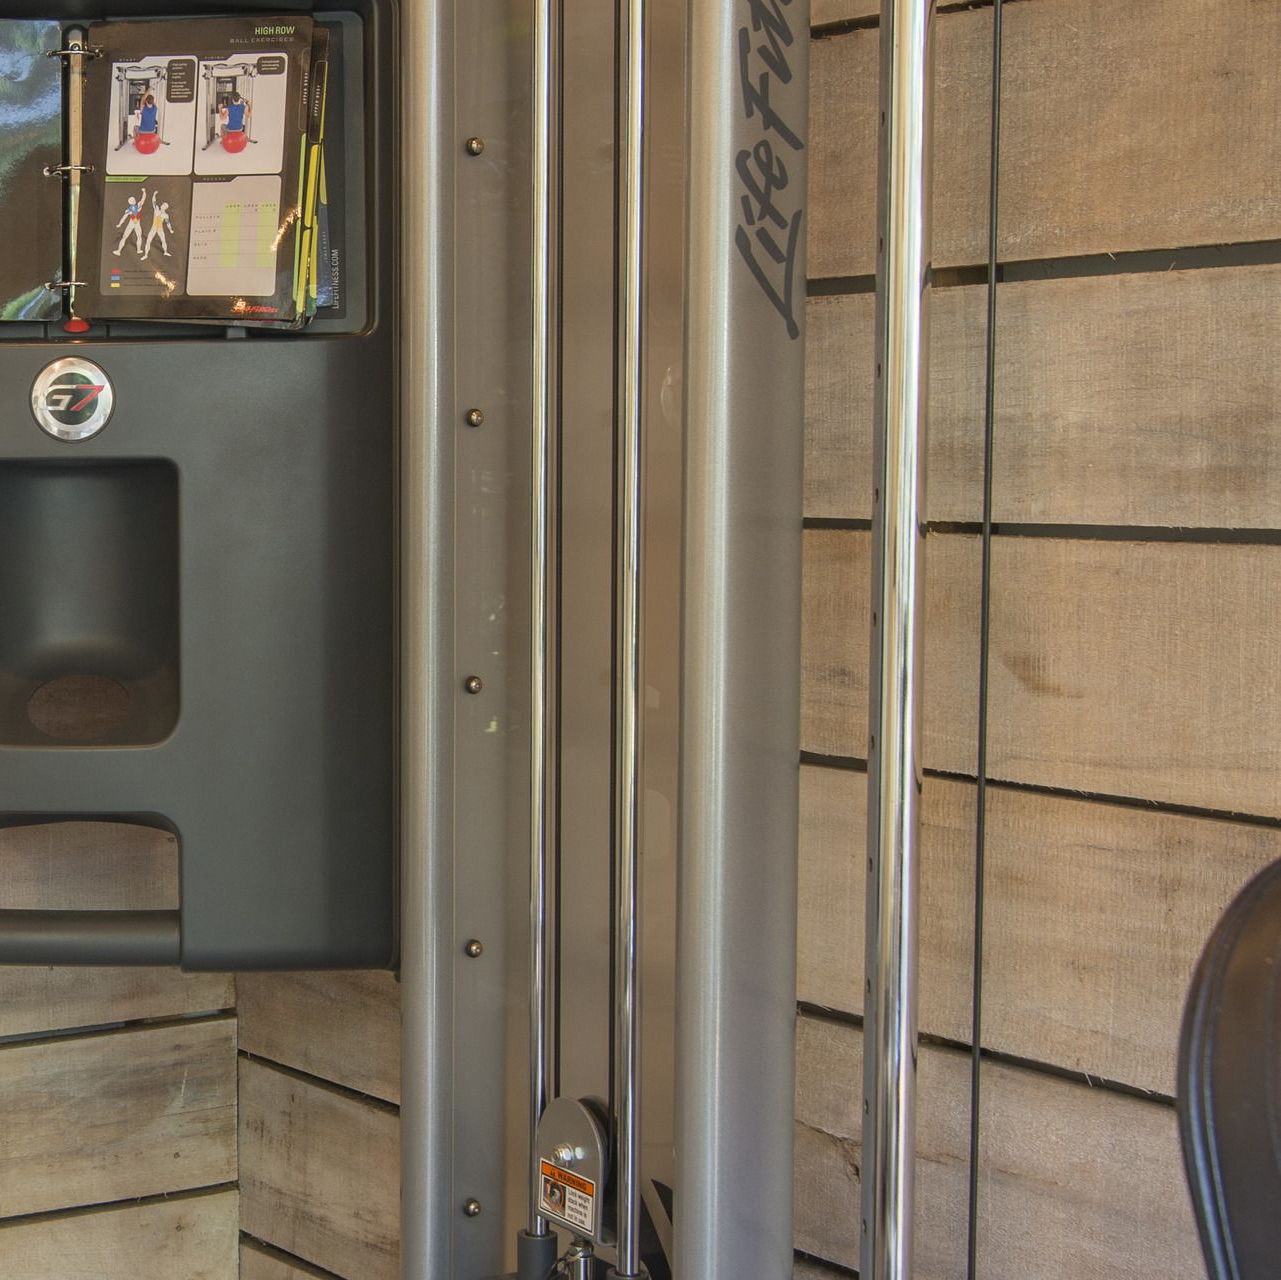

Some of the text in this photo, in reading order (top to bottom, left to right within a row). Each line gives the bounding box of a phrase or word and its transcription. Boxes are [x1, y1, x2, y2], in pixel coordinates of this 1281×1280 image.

[254, 25, 295, 35] HIGH ROW
[44, 383, 105, 412] G7
[557, 1171, 587, 1191] WARNING
